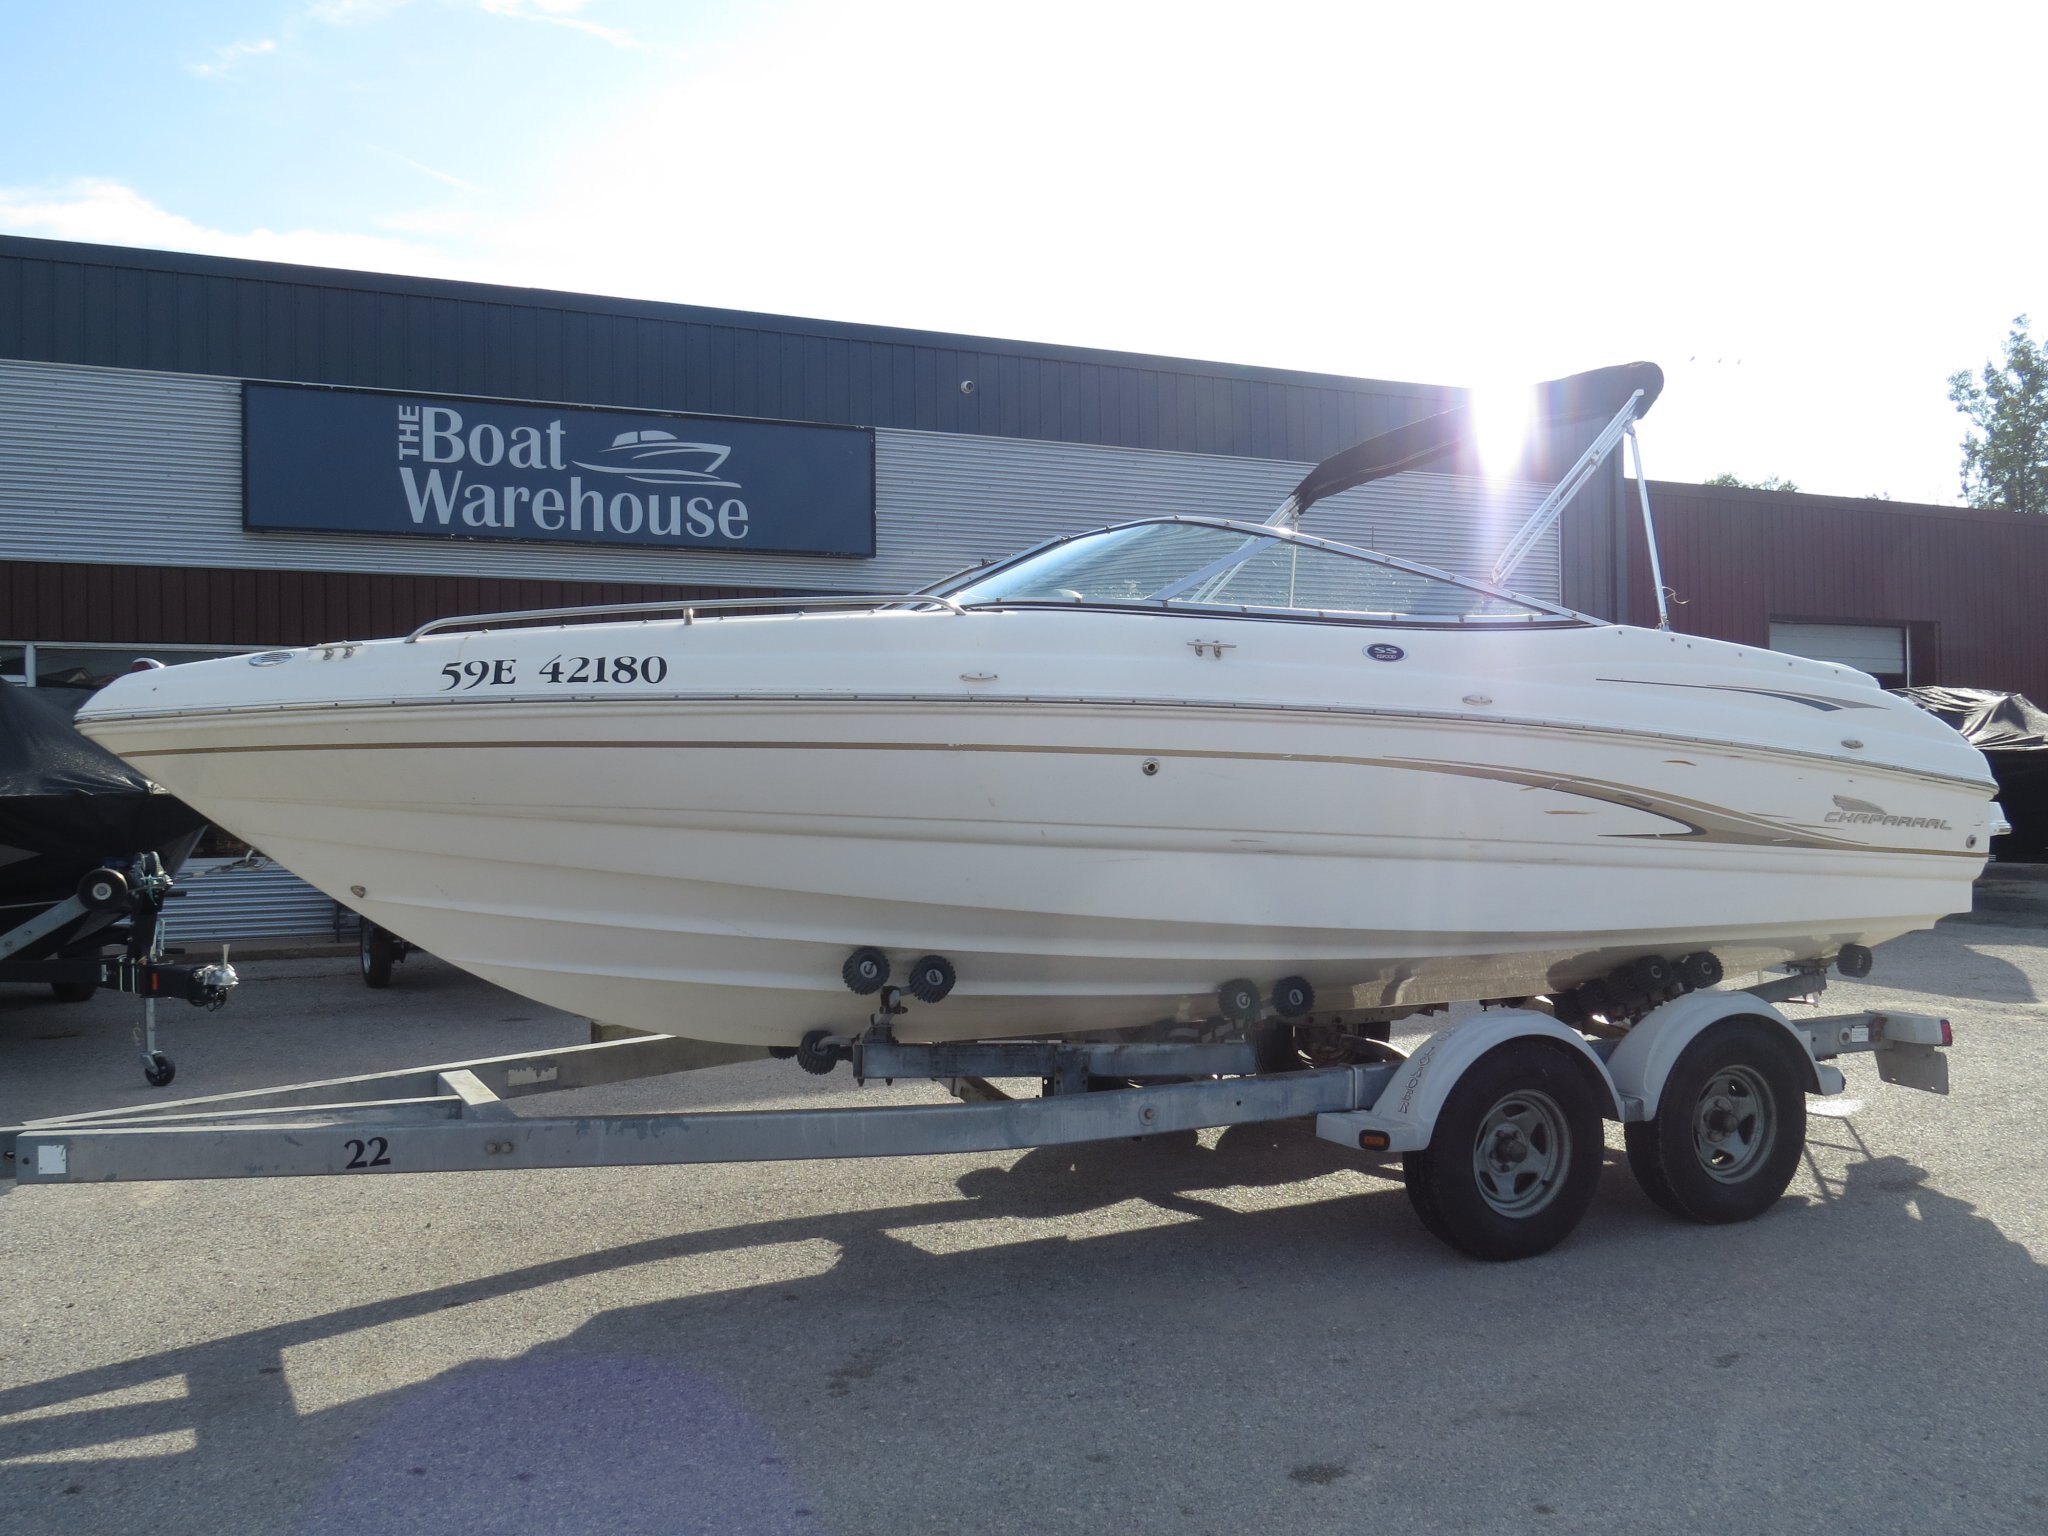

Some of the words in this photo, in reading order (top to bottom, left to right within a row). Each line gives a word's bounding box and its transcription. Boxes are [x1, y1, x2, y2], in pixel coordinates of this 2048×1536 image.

[398, 405, 420, 461] THE
[422, 406, 568, 471] Boat
[399, 466, 749, 540] Warehouse
[1373, 647, 1398, 655] SS
[439, 658, 517, 692] 59E
[538, 654, 668, 684] 42180
[1823, 811, 1953, 831] CHAPARRAL
[343, 1136, 392, 1170] 22
